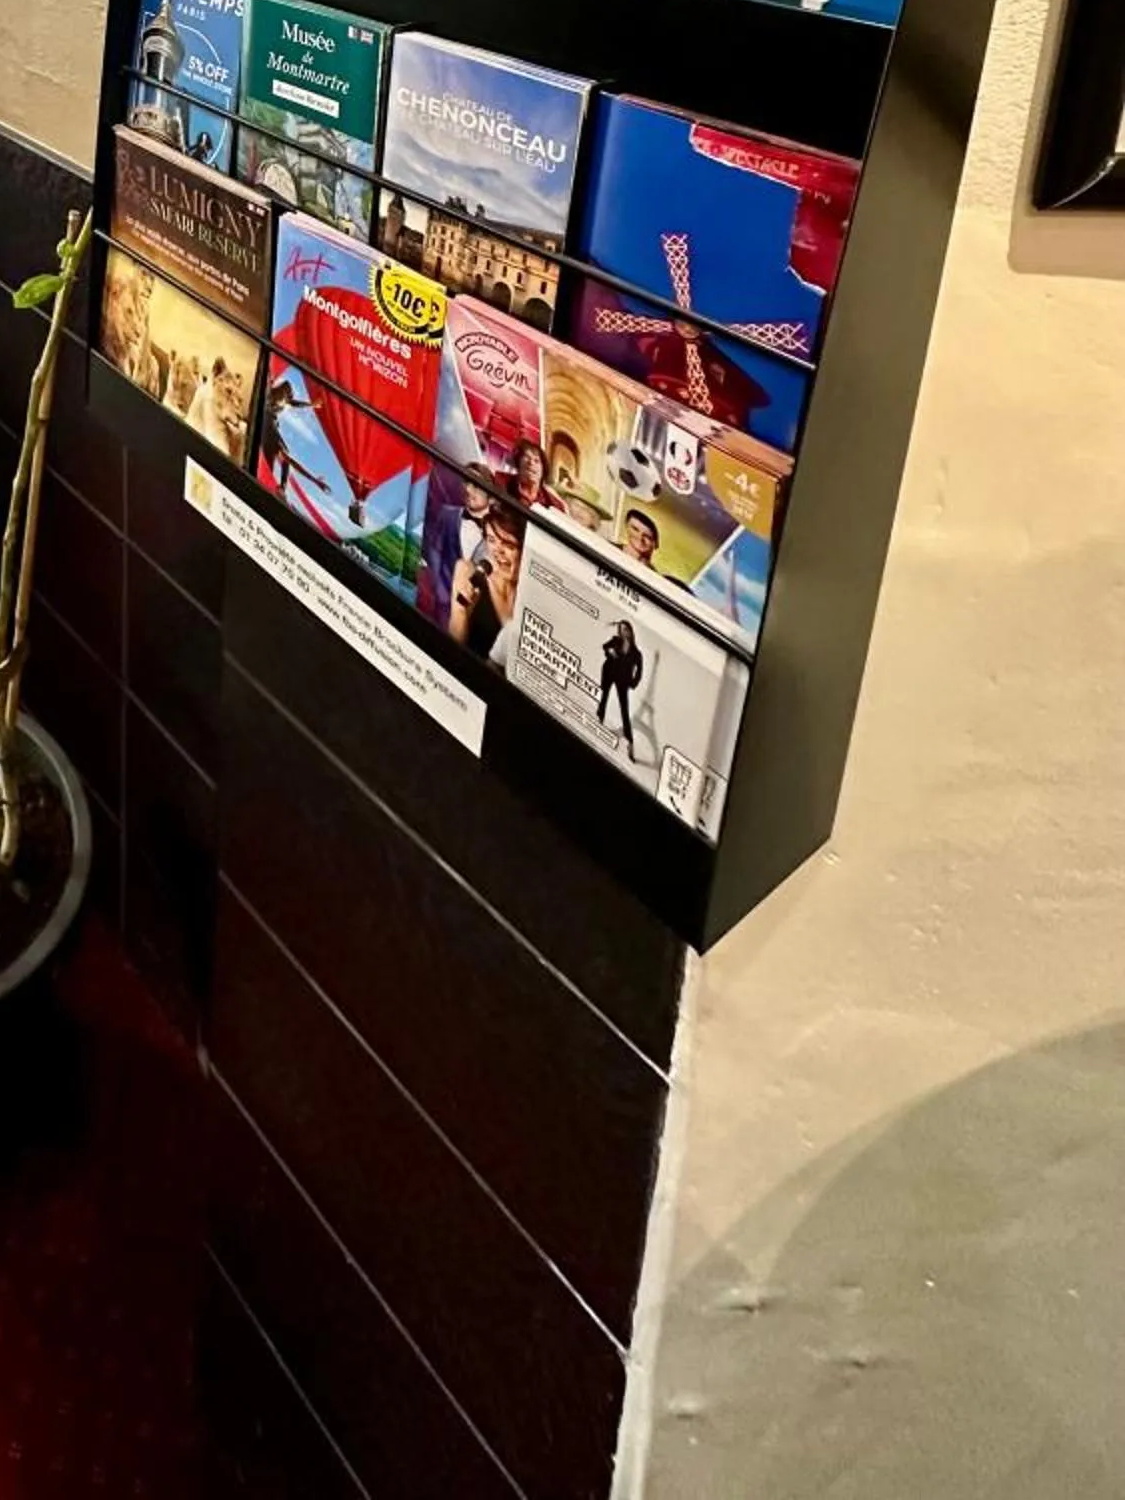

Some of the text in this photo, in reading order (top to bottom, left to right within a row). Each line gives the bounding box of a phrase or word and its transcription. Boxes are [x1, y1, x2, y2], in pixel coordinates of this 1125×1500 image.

[177, 3, 206, 21] PARIS
[281, 19, 336, 53] Musée
[189, 56, 203, 74] 5%
[205, 62, 229, 82] OFF
[266, 52, 351, 95] Montmartre
[302, 51, 314, 65] de
[396, 87, 567, 163] CHENONCEAU
[150, 164, 263, 248] LUMIGNY
[303, 284, 412, 360] Montgolfières
[358, 354, 409, 389] HORIZON
[364, 344, 409, 377] NOUVEL
[527, 612, 549, 634] THE
[524, 624, 577, 668] PARISIAN
[522, 636, 601, 697] DEPARTMENT
